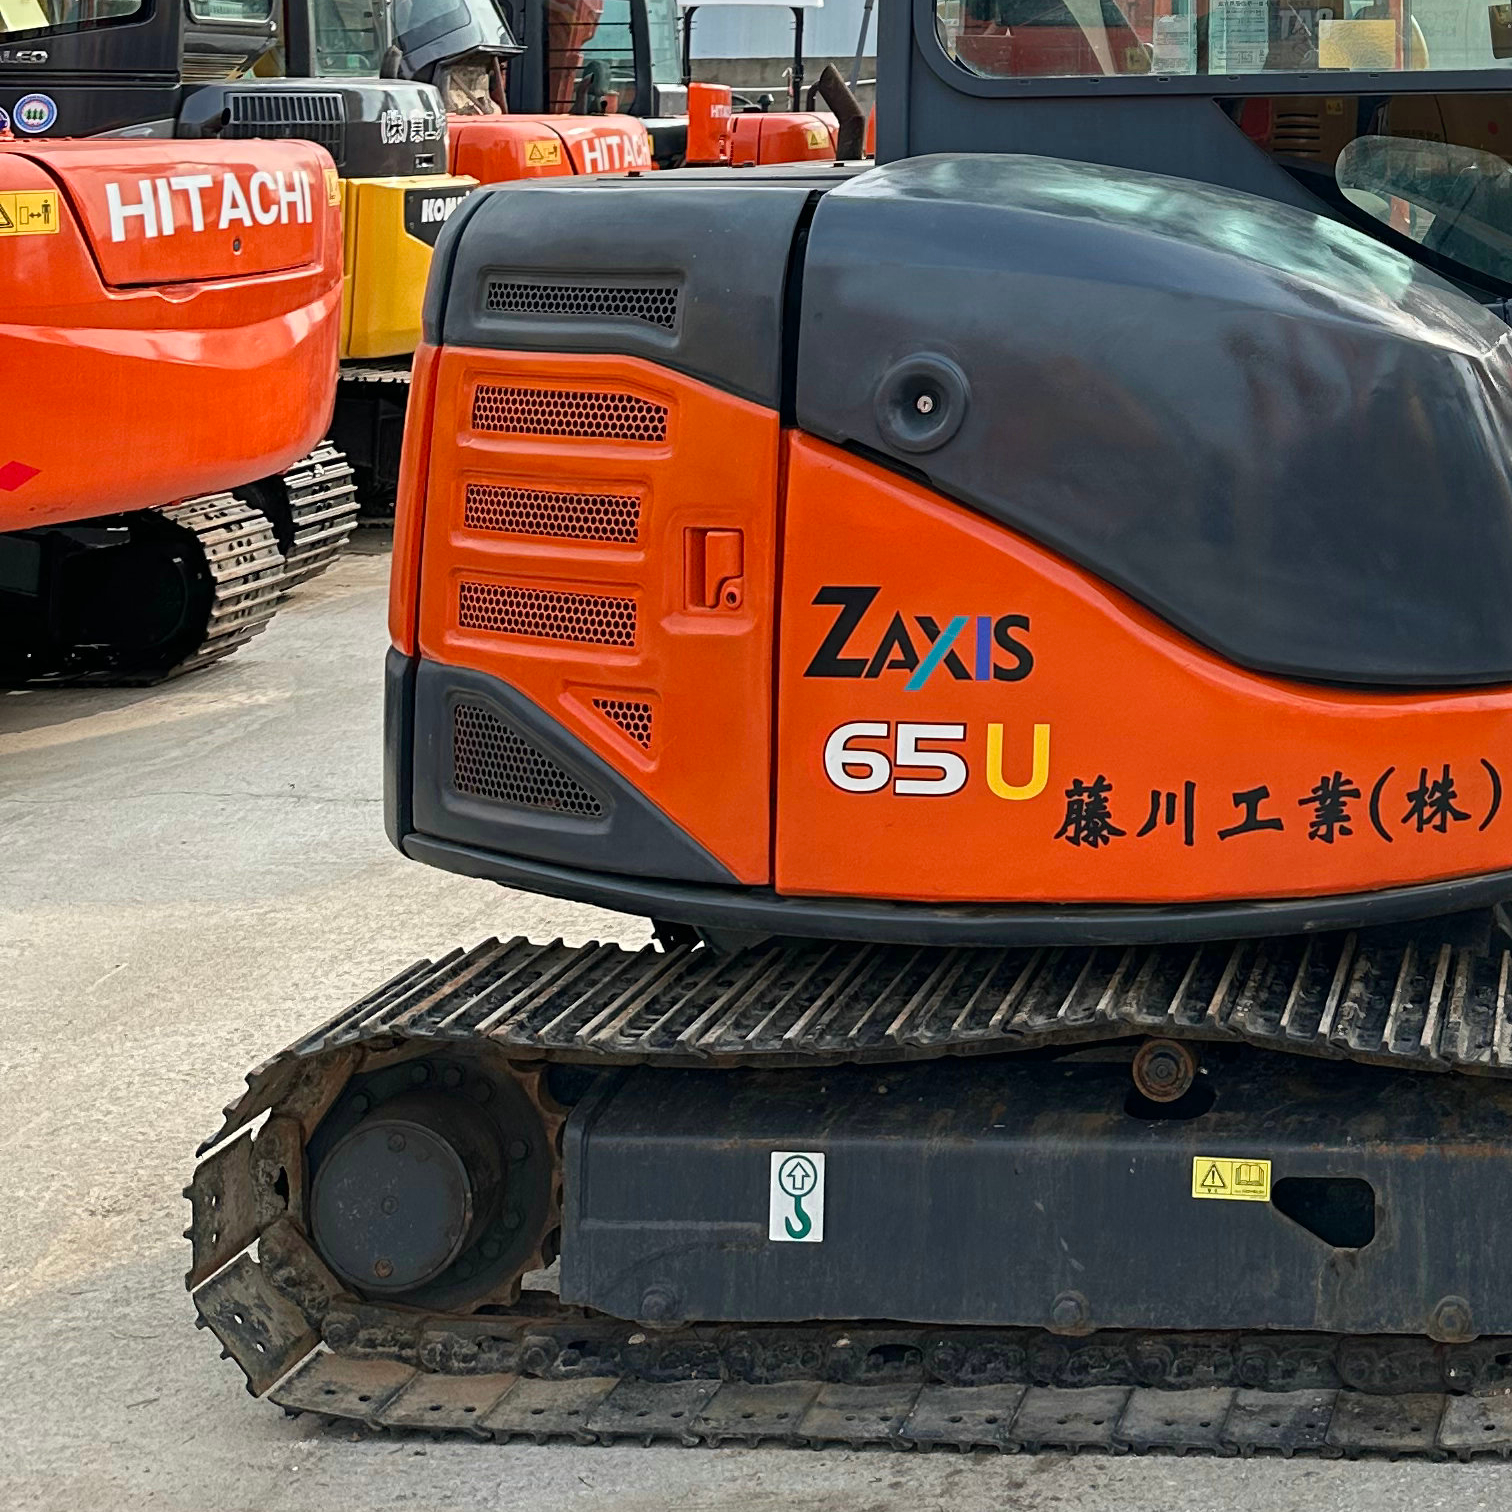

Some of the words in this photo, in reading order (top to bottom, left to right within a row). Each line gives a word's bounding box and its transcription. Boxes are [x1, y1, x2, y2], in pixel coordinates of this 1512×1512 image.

[106, 171, 313, 242] HITACHI
[803, 586, 1035, 691] ZAXIS
[1053, 757, 1502, 849] 藤川工業(株)
